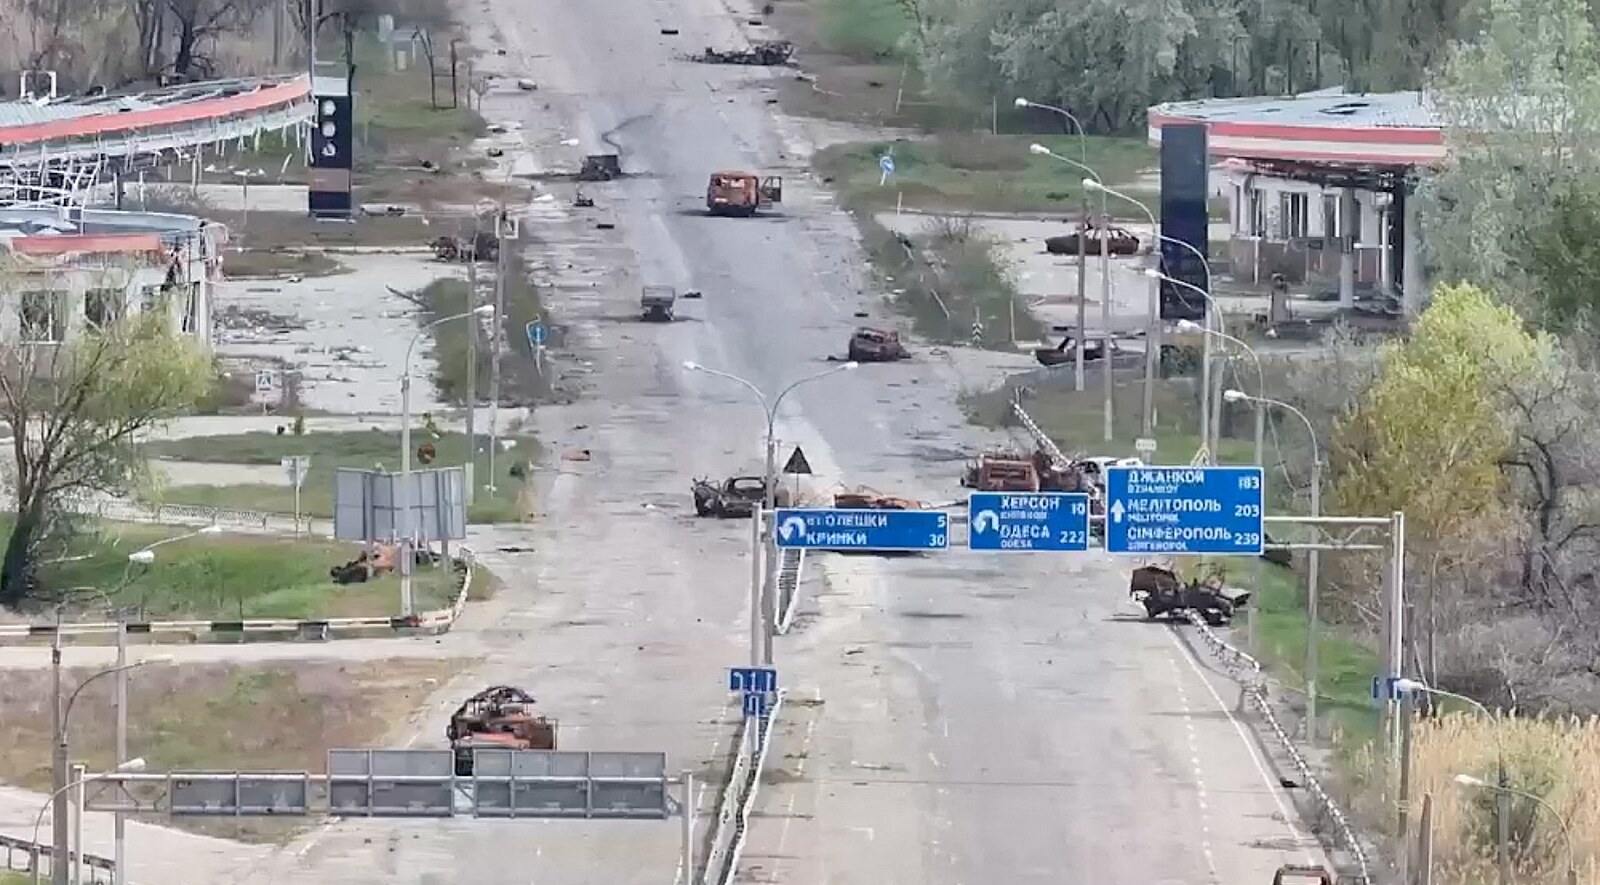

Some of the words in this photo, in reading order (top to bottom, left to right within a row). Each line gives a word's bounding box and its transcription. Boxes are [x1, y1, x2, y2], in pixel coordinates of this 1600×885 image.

[1128, 470, 1204, 484] ДЖАНКОЙ
[1238, 477, 1259, 489] 183
[1001, 496, 1060, 510] ХЕРСОН
[1071, 503, 1085, 515] 10
[1128, 499, 1222, 512] МЕЛІТОПОЛЬ
[1234, 505, 1259, 517] 203
[825, 514, 888, 527] ОЛЕШКИ
[937, 516, 946, 528] 5
[806, 533, 867, 545] КРИНКИ
[929, 534, 945, 546] 30
[1000, 525, 1050, 538] ОДЕСА
[1060, 531, 1085, 543] 222
[1127, 527, 1232, 540] СІМФЕРОПОЛЬ
[1234, 533, 1259, 545] 239
